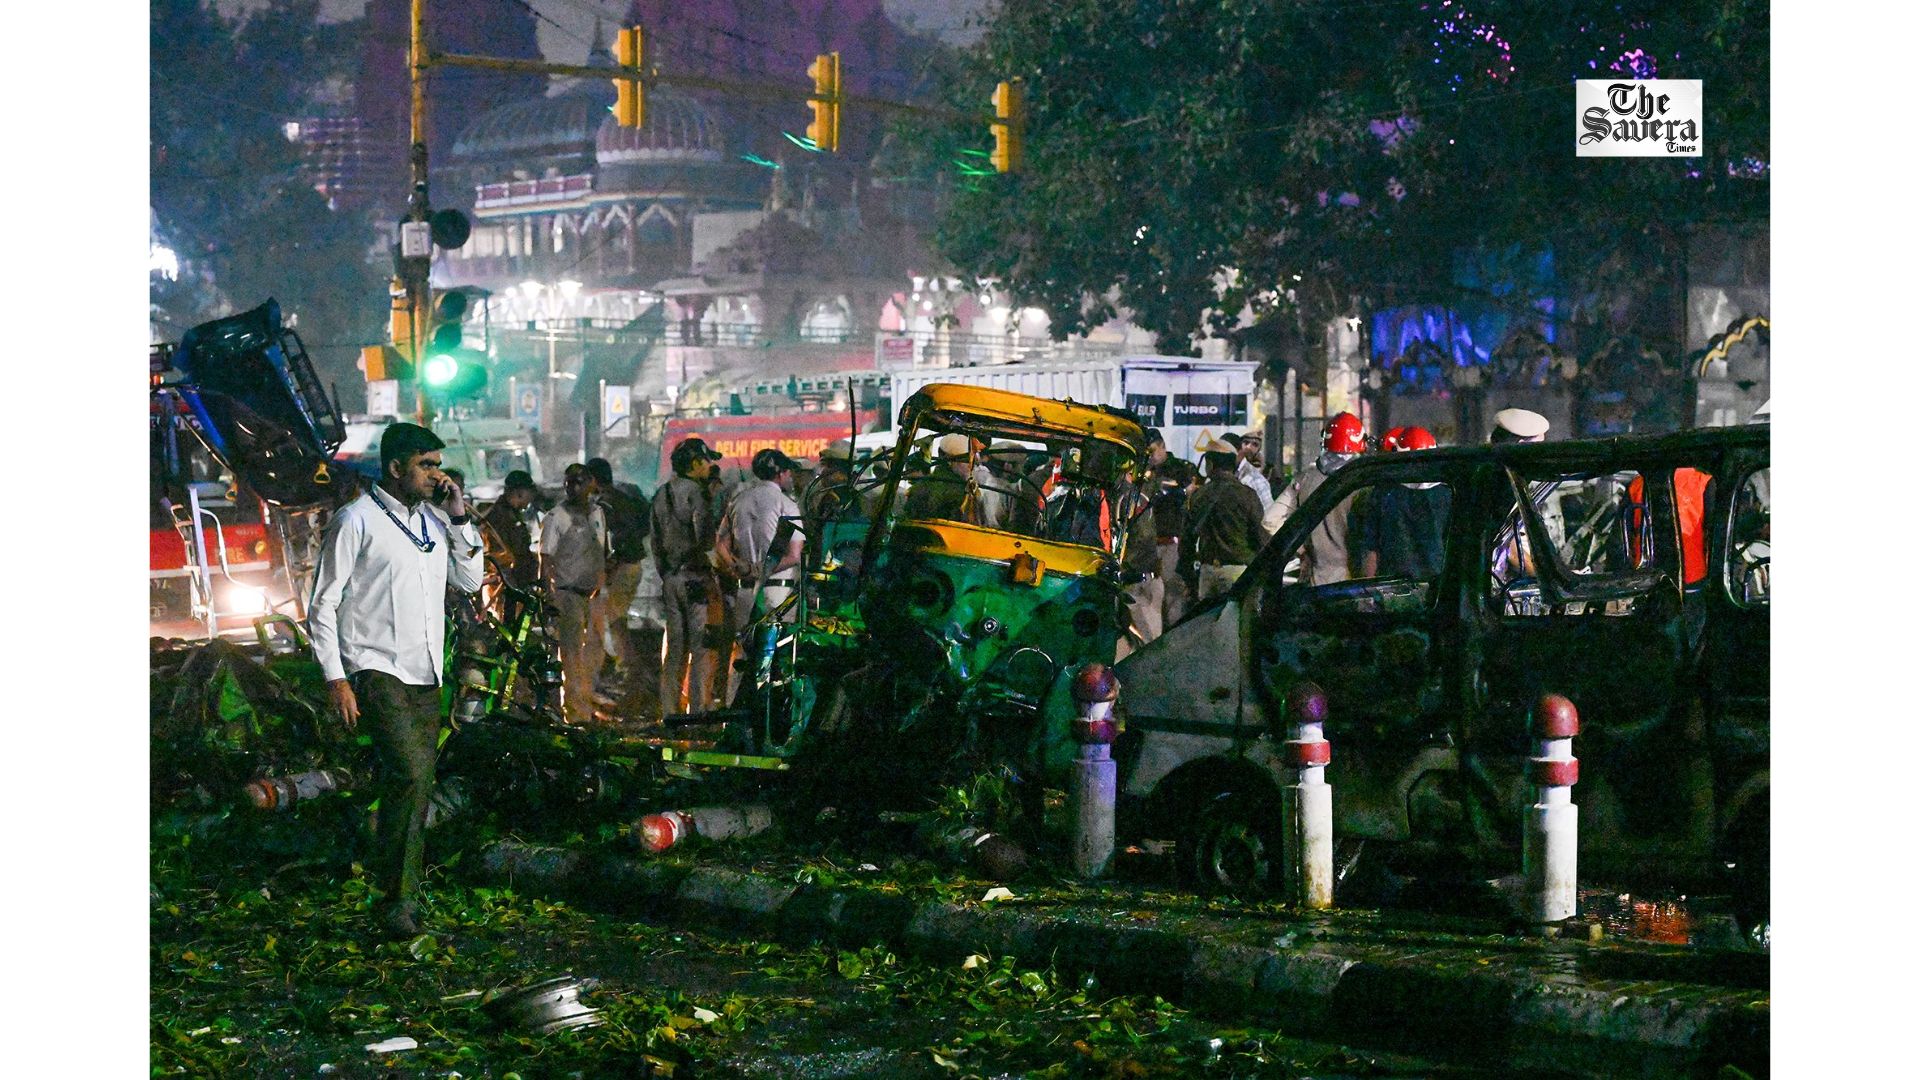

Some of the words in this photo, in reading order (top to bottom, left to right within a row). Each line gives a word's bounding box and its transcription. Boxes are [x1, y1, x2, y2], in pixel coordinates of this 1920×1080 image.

[1174, 405, 1218, 415] TURBO
[715, 440, 748, 457] DELHI
[779, 439, 828, 457] SERVICE
